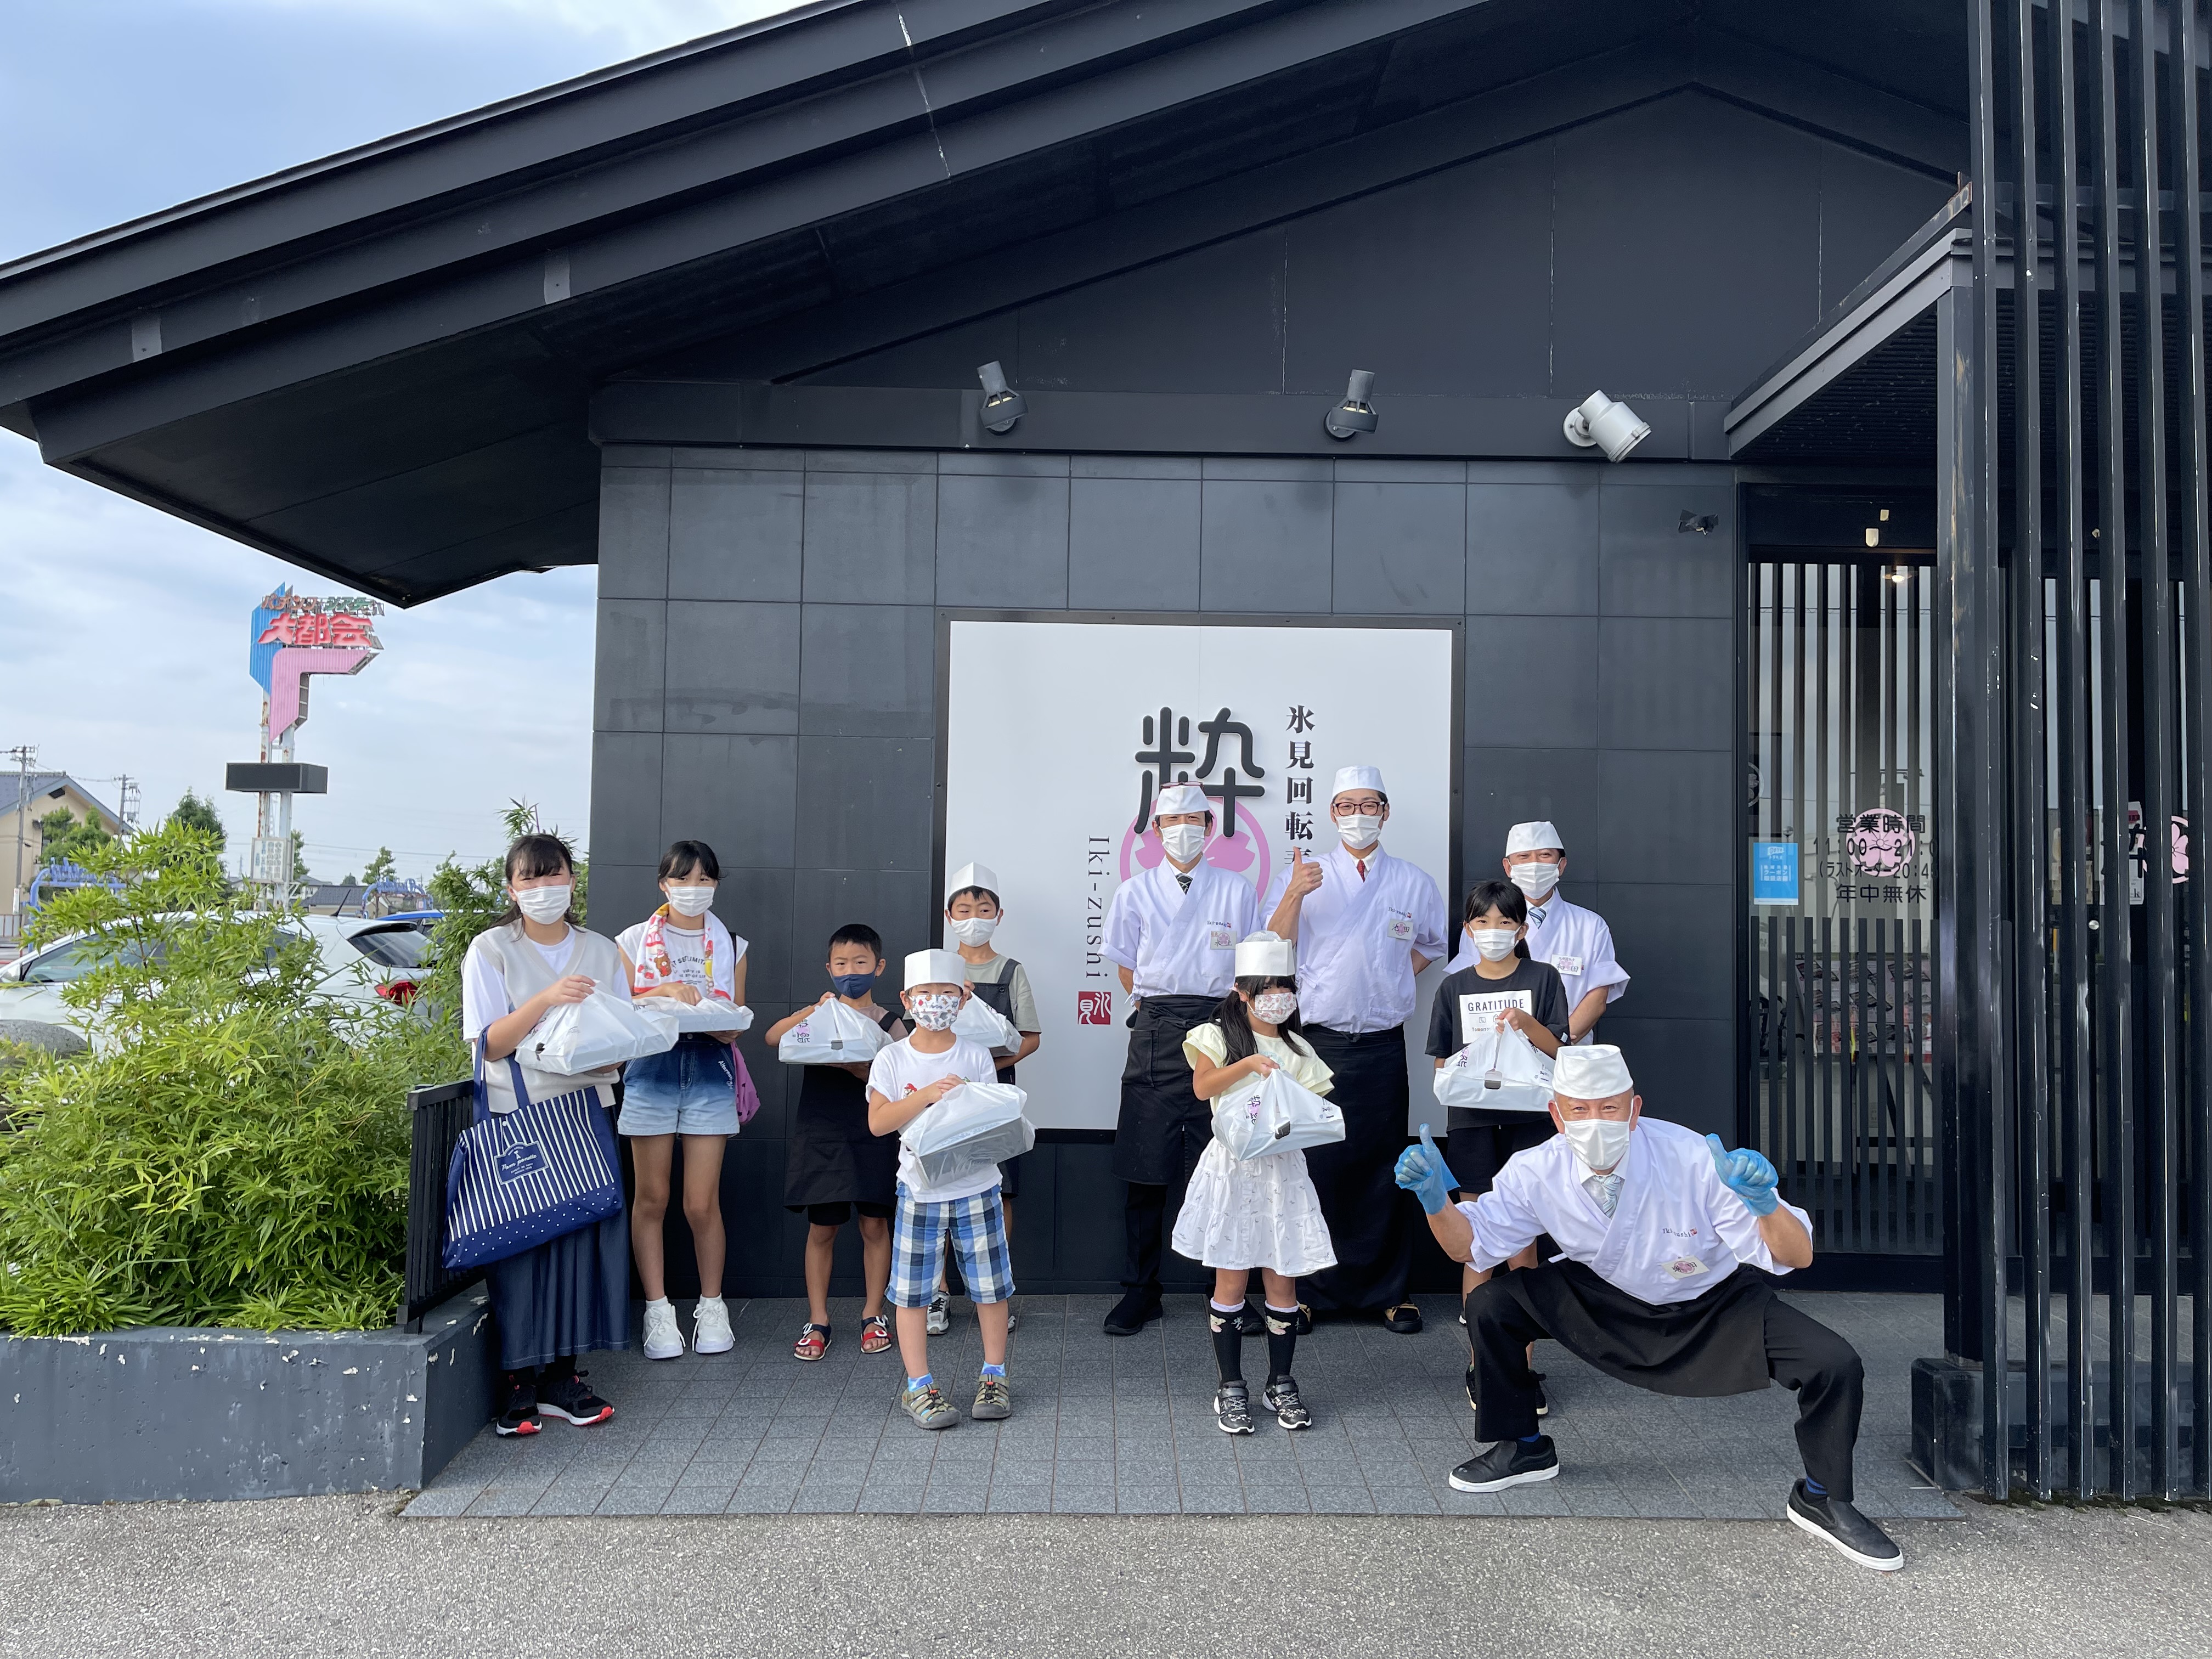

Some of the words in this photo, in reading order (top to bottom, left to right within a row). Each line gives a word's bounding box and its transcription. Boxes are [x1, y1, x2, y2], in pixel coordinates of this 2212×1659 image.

[258, 612, 373, 646] 大都会
[1135, 706, 1265, 838] 粋
[1836, 814, 1926, 833] 営業時間
[1086, 834, 1111, 979] Iki-zushi
[1836, 884, 1927, 903] 年中無休
[1468, 998, 1525, 1012] GRATITUDE
